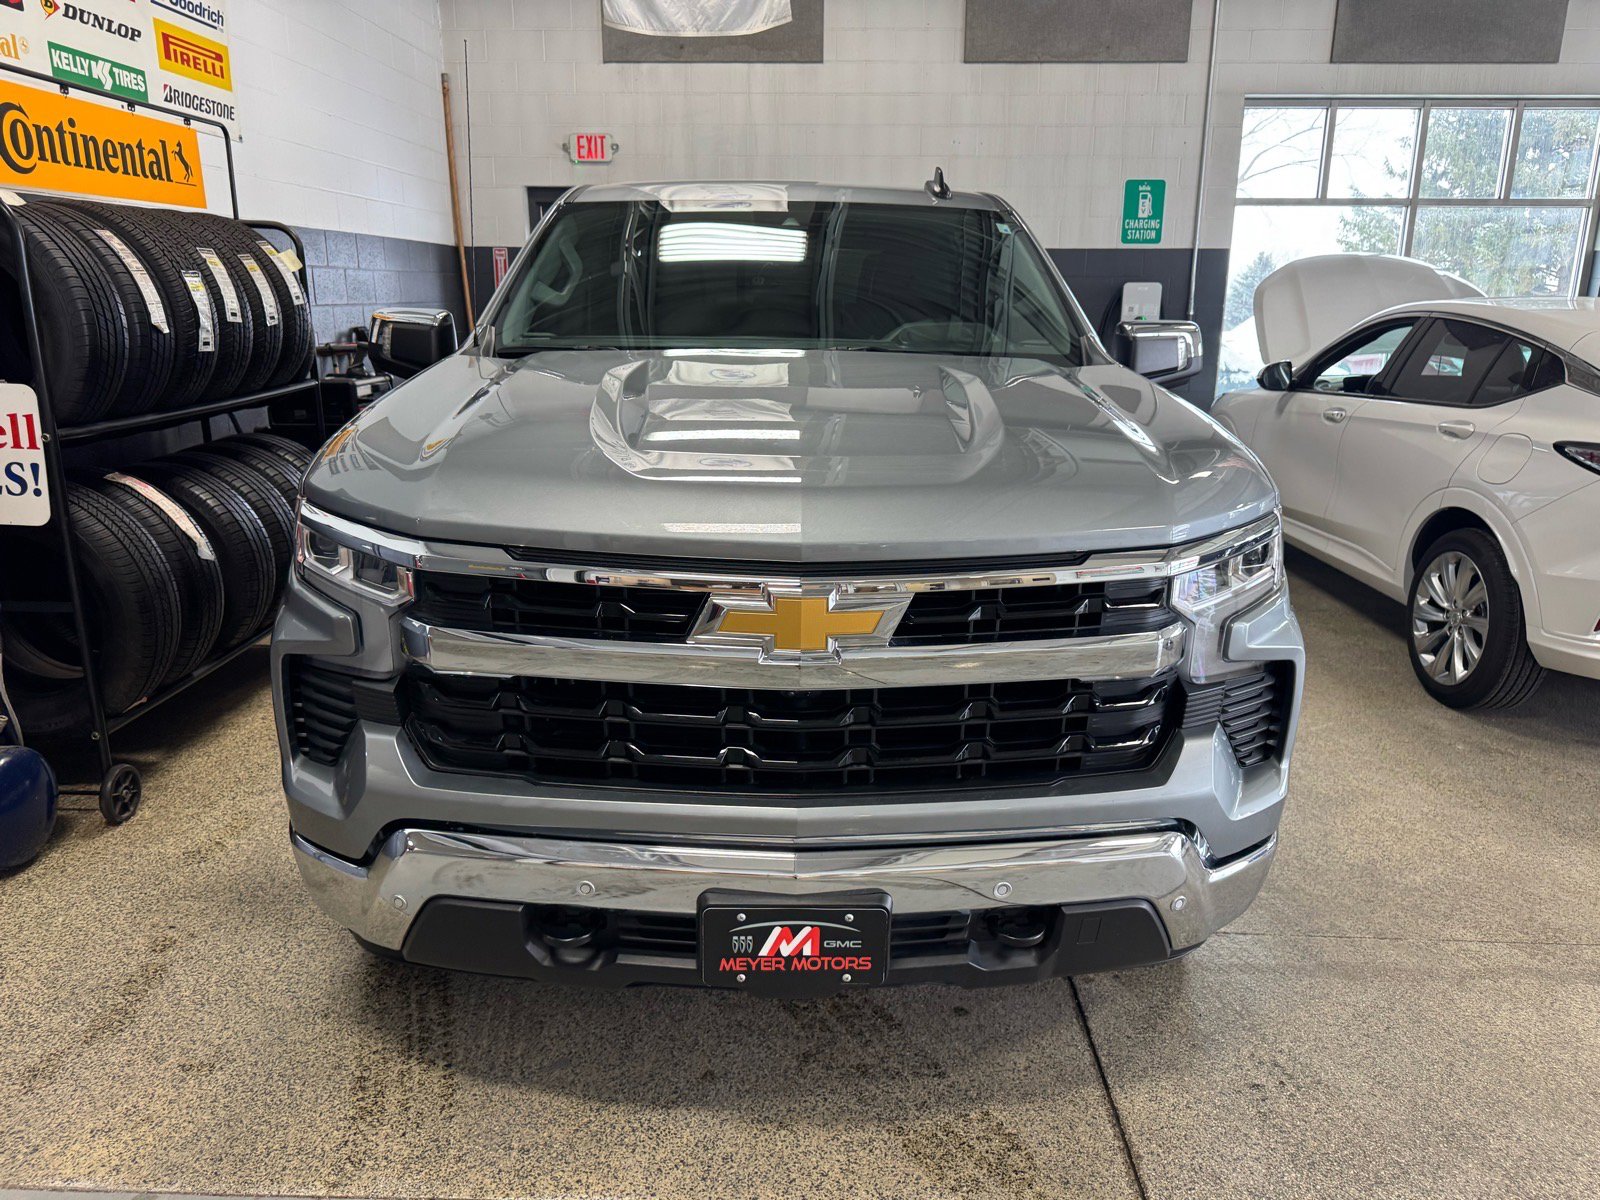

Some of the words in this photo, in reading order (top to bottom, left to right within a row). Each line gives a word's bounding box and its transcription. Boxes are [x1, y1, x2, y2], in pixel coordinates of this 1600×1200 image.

[62, 3, 142, 42] DUNLOP
[51, 48, 90, 77] KELLY
[112, 67, 146, 93] TIRES
[161, 31, 225, 80] PIRELLI
[163, 84, 235, 121] BRIDGESTONE
[0, 101, 174, 183] Continental
[576, 134, 606, 160] EXIT
[1124, 219, 1160, 230] CHARGING
[1126, 230, 1156, 240] STATION
[0, 461, 42, 497] S!
[823, 940, 862, 948] GMC
[719, 956, 786, 972] MEYER
[790, 956, 873, 972] MOTORS
